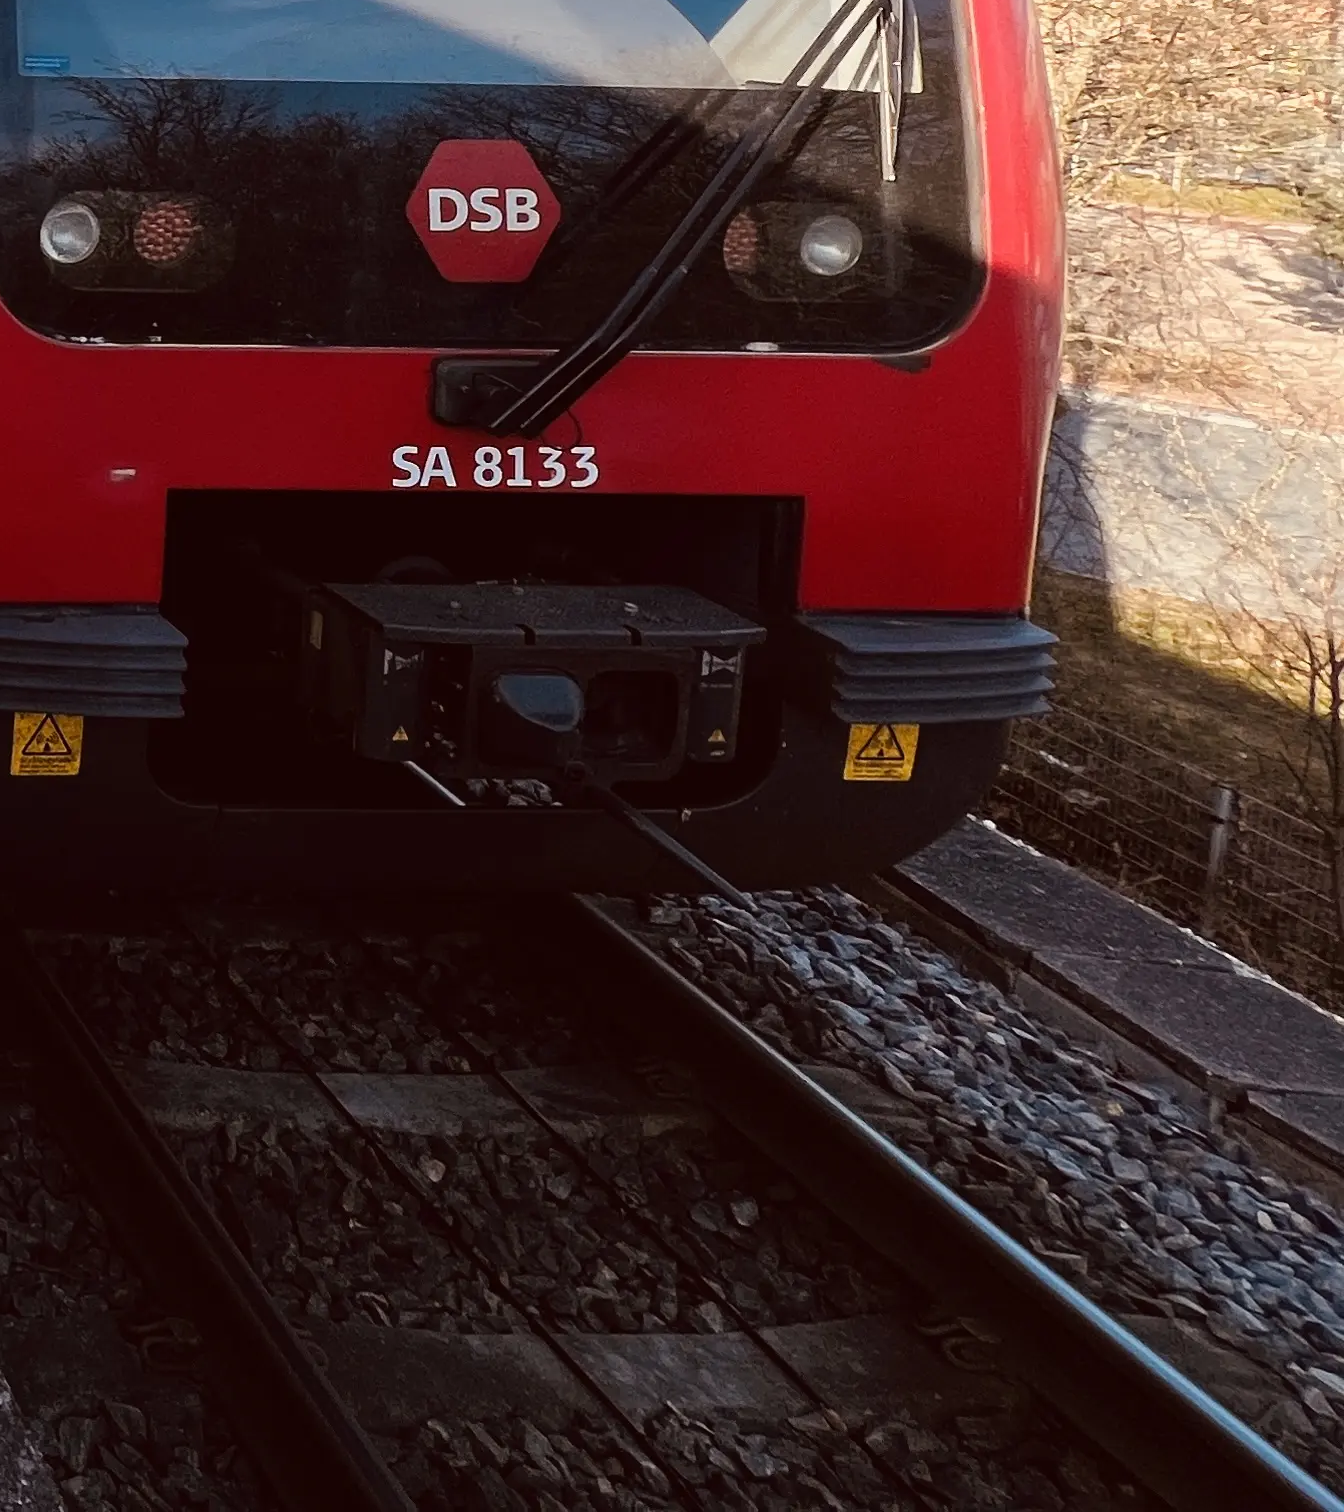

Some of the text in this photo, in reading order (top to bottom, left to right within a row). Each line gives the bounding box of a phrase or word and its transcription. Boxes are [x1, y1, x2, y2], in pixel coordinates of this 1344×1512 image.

[428, 188, 540, 231] DSB
[392, 446, 599, 488] SA 8133
